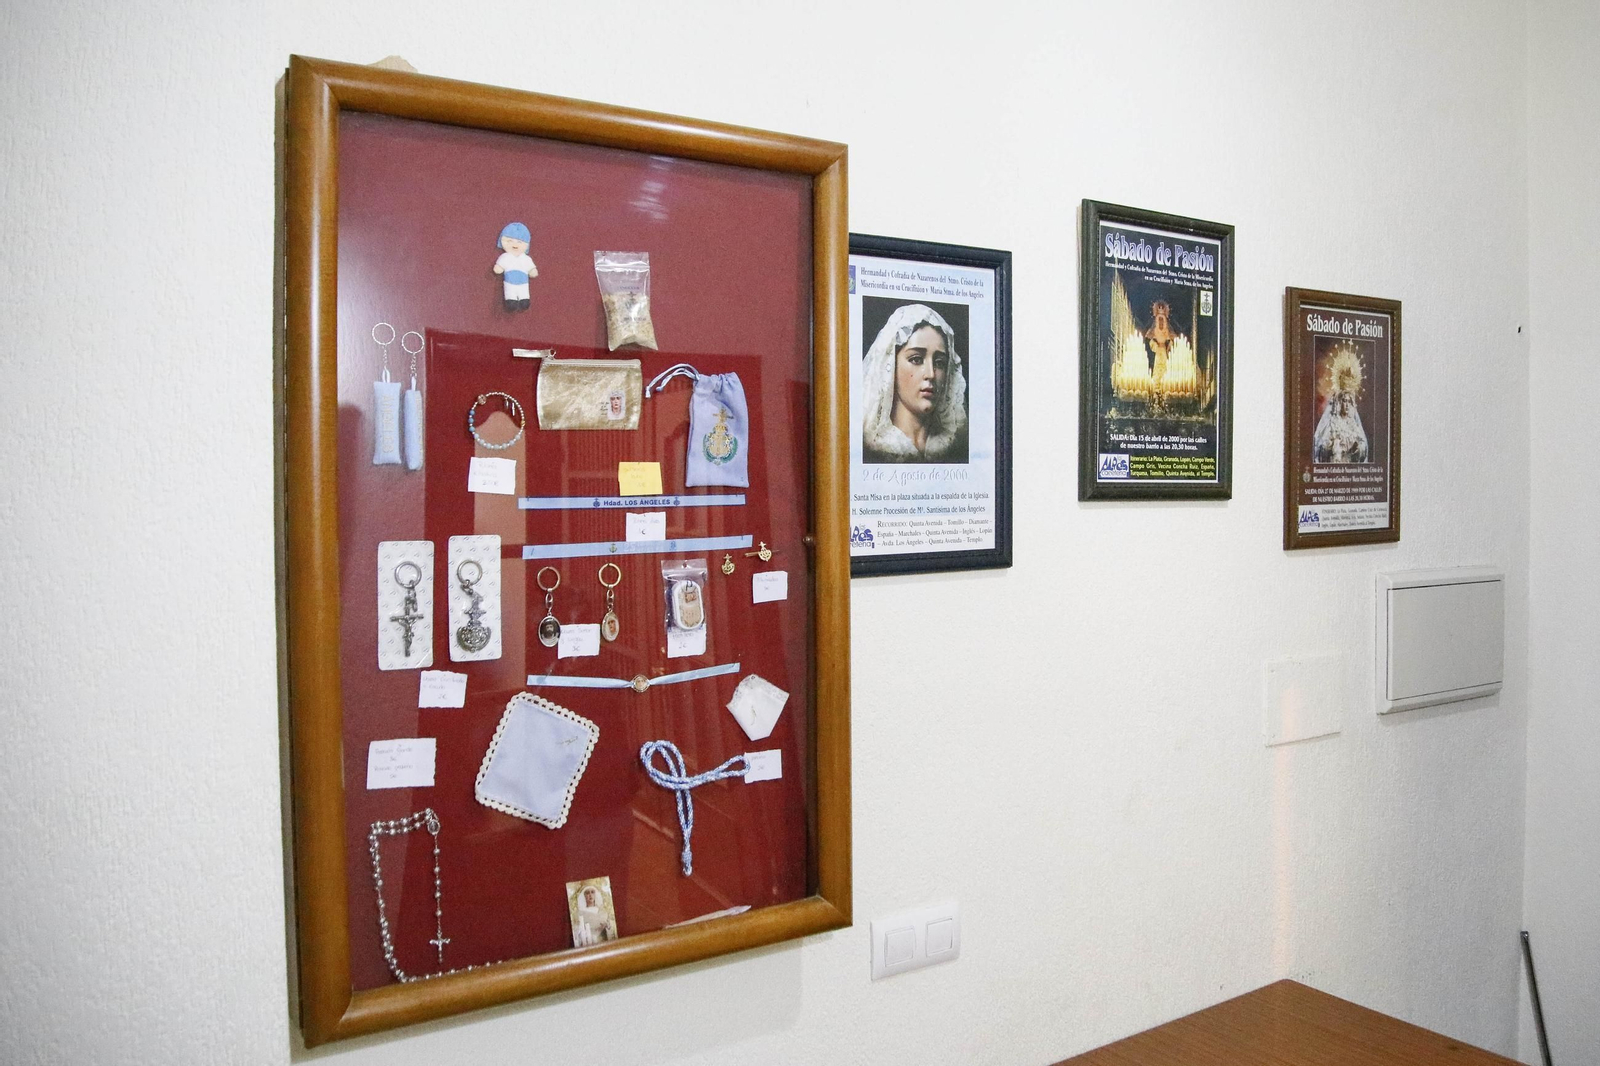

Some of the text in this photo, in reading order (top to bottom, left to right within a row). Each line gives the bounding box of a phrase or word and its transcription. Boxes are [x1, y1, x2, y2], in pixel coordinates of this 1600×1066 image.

[1105, 232, 1215, 273] Sábado de Pasión
[1307, 313, 1384, 339] Sábado de Pasión
[1110, 433, 1129, 442] SALIDA:
[1169, 435, 1180, 443] 2000
[863, 467, 969, 487] 2 de Agosto de 2000
[603, 499, 623, 507] Hdad.
[853, 493, 869, 502] Santa
[870, 493, 882, 501] Misa
[891, 493, 896, 501] la
[897, 493, 911, 503] plaza
[911, 493, 930, 501] situada
[941, 492, 960, 502] espalda
[960, 492, 967, 500] de
[967, 492, 972, 500] la
[859, 507, 882, 515] Solemne
[884, 506, 909, 515] Procesión
[951, 505, 958, 513] de
